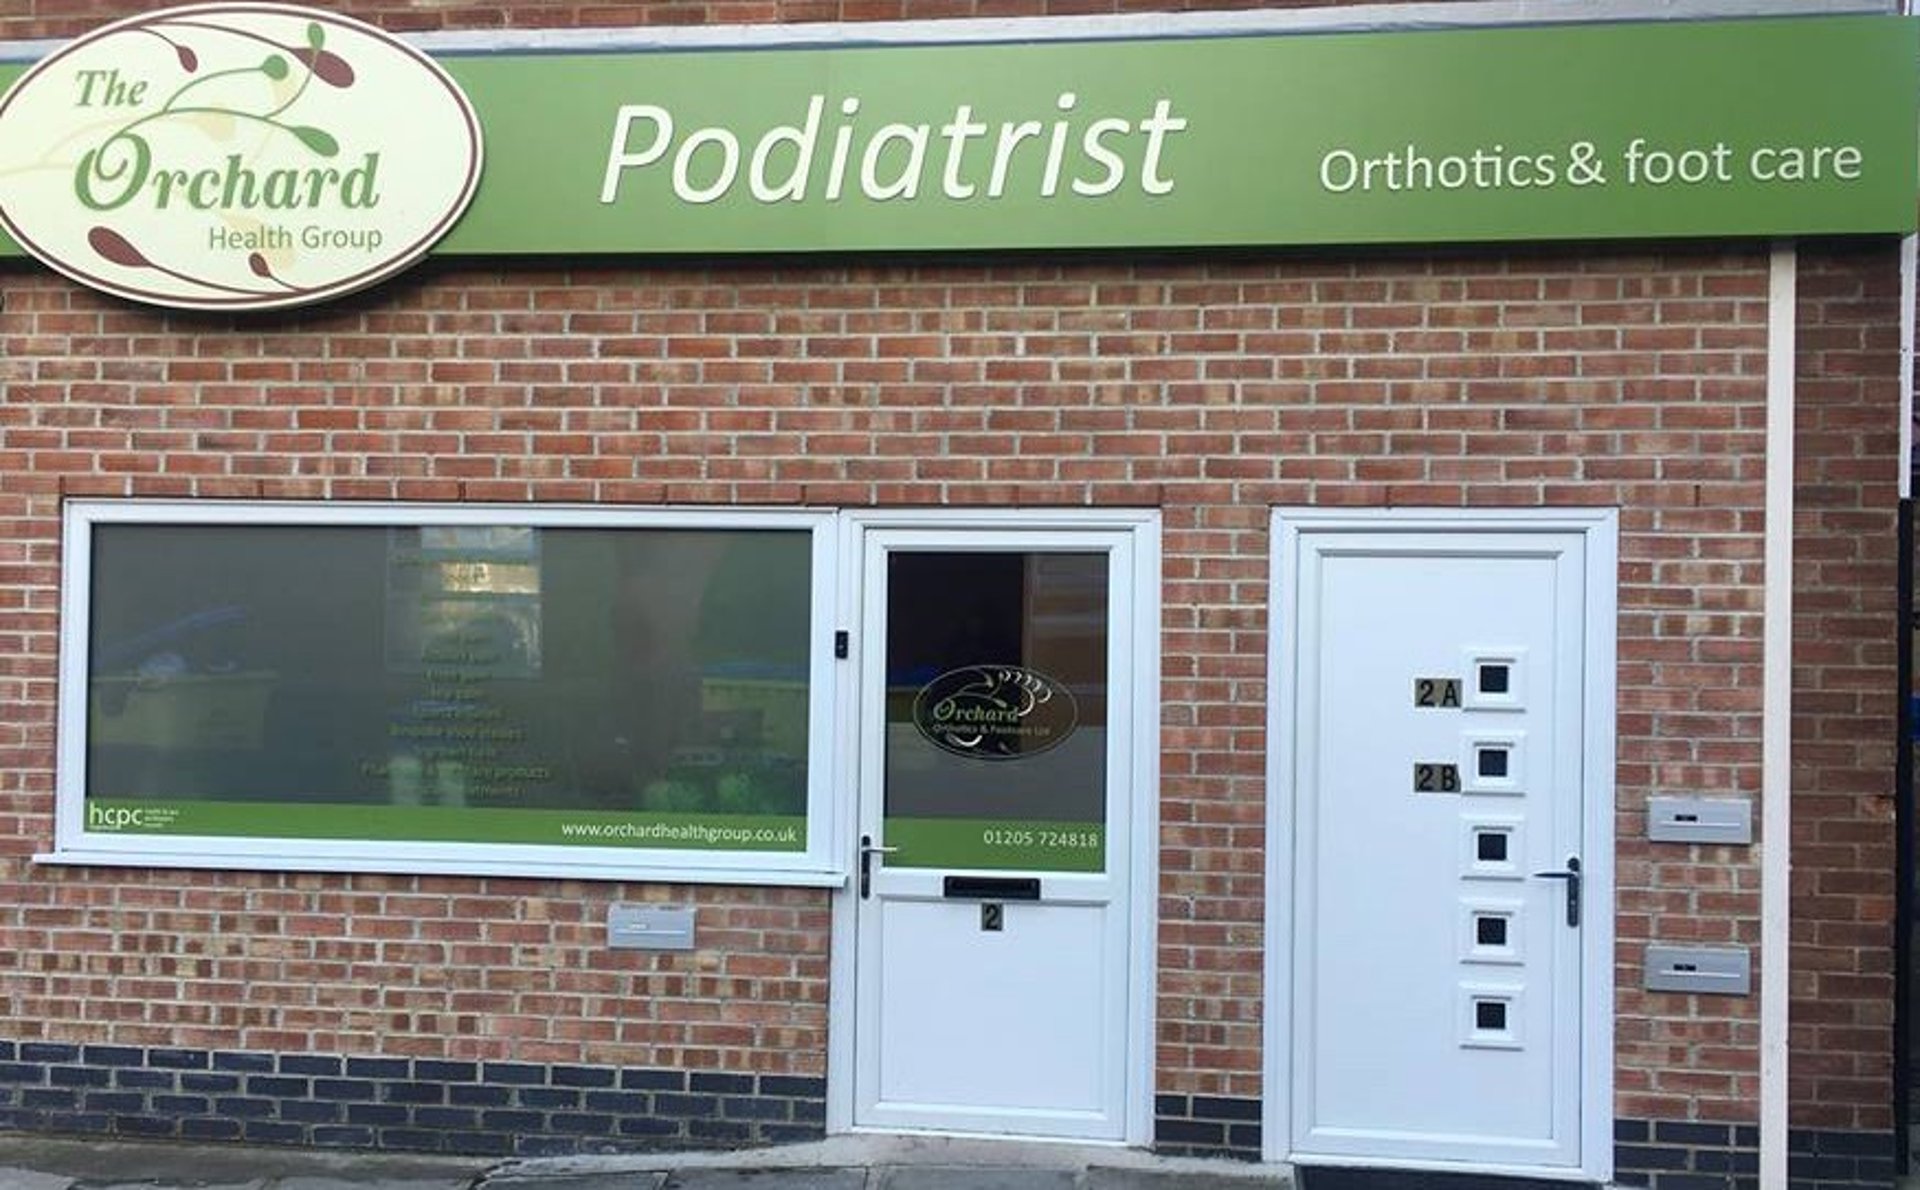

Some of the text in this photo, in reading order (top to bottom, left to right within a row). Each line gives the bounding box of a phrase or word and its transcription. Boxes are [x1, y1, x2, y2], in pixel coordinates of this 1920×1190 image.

[74, 69, 149, 107] The
[600, 92, 1187, 203] Podiatrist
[74, 132, 381, 211] Orchard
[1319, 138, 1863, 191] Orthotics & foot care
[209, 226, 382, 253] Health Group
[1419, 680, 1458, 706] 2A
[933, 698, 1020, 723] Orchard
[1419, 764, 1457, 792] 2B
[89, 801, 143, 830] hcpc
[561, 823, 798, 843] www.orchardhealthgroup.co.uk
[983, 829, 1099, 847] 01205 724818
[985, 903, 999, 930] 2
